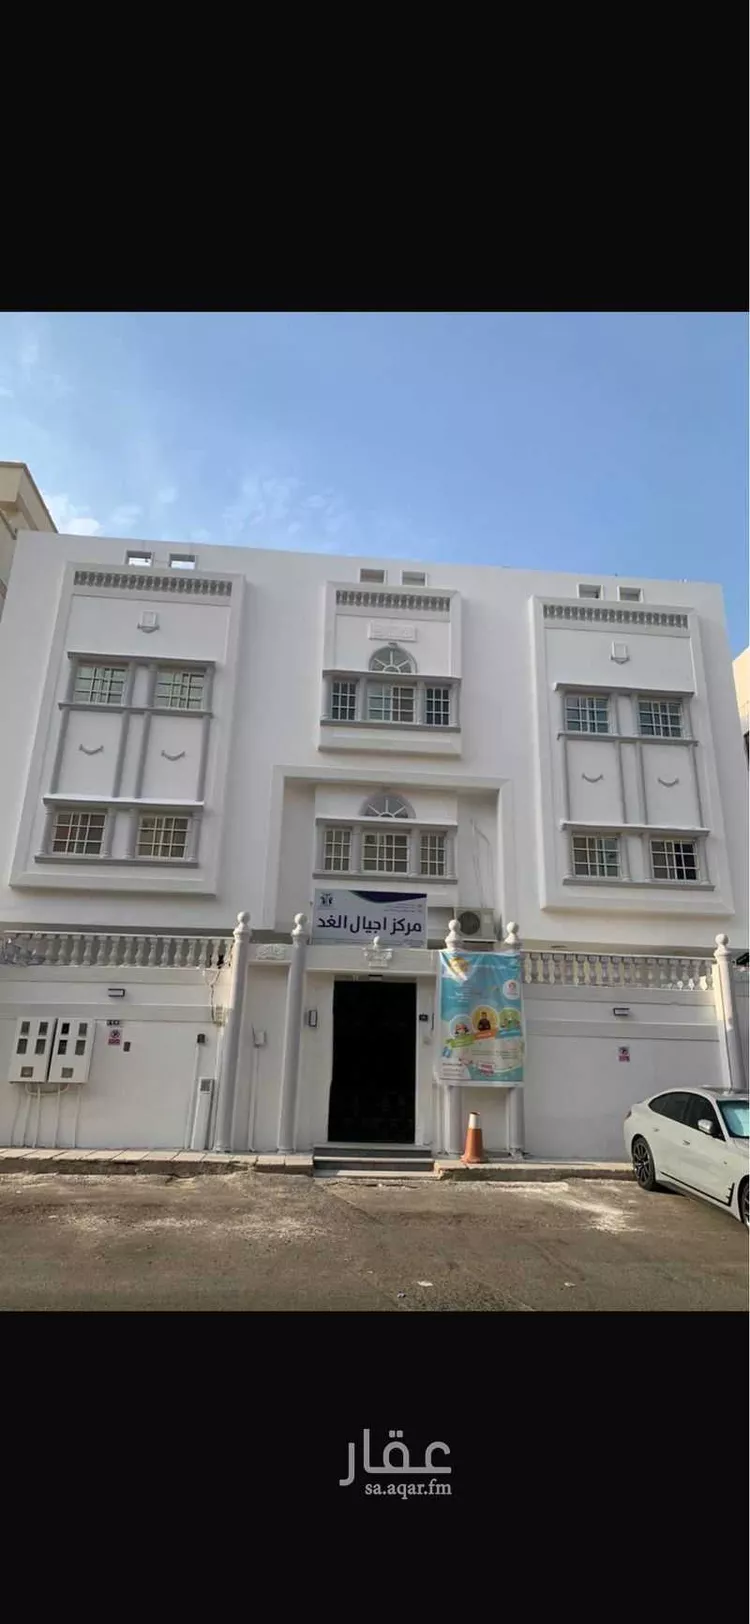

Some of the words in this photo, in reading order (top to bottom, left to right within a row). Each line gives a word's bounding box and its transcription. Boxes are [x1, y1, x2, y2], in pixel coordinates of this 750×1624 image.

[317, 914, 347, 929] الغد
[350, 915, 387, 934] اجيال
[390, 917, 422, 936] مركز
